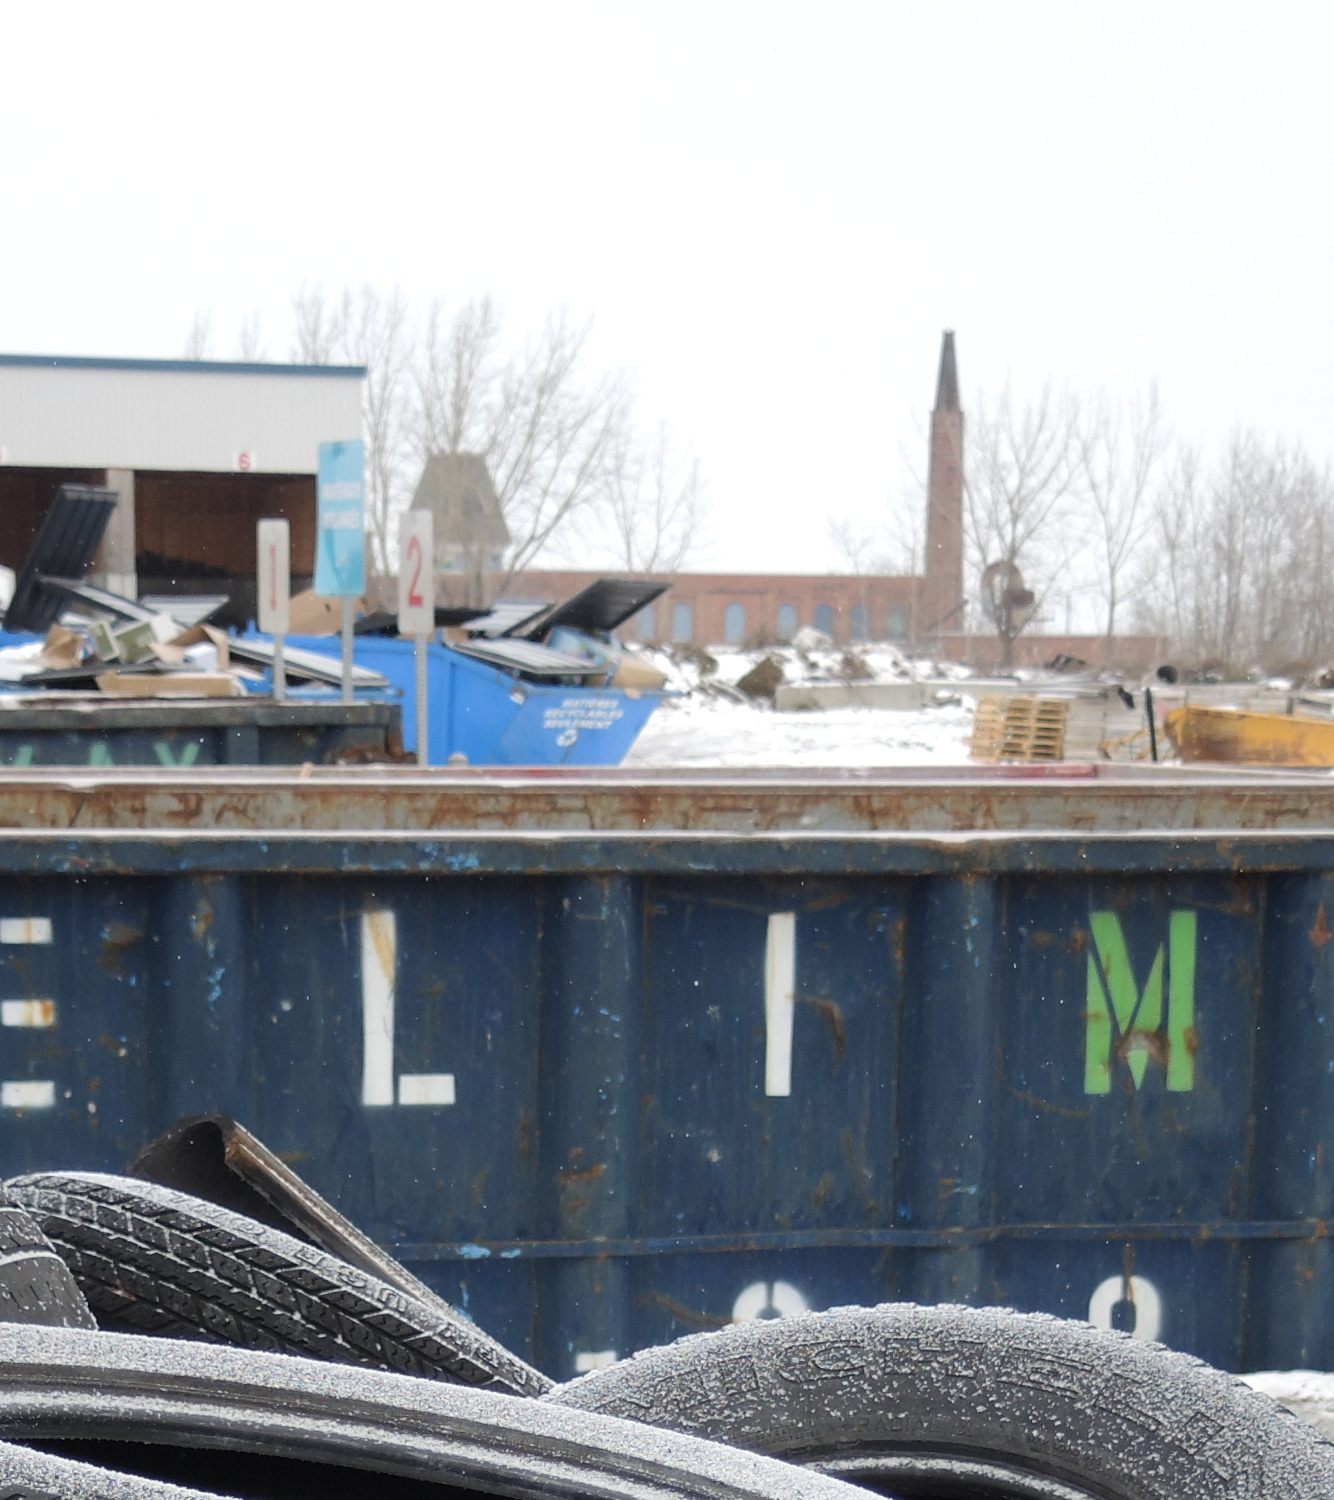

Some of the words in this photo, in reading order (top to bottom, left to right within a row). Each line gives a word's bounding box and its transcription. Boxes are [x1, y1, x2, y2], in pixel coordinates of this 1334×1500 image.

[238, 453, 251, 472] 6
[269, 544, 277, 610] 1
[407, 535, 424, 607] 2
